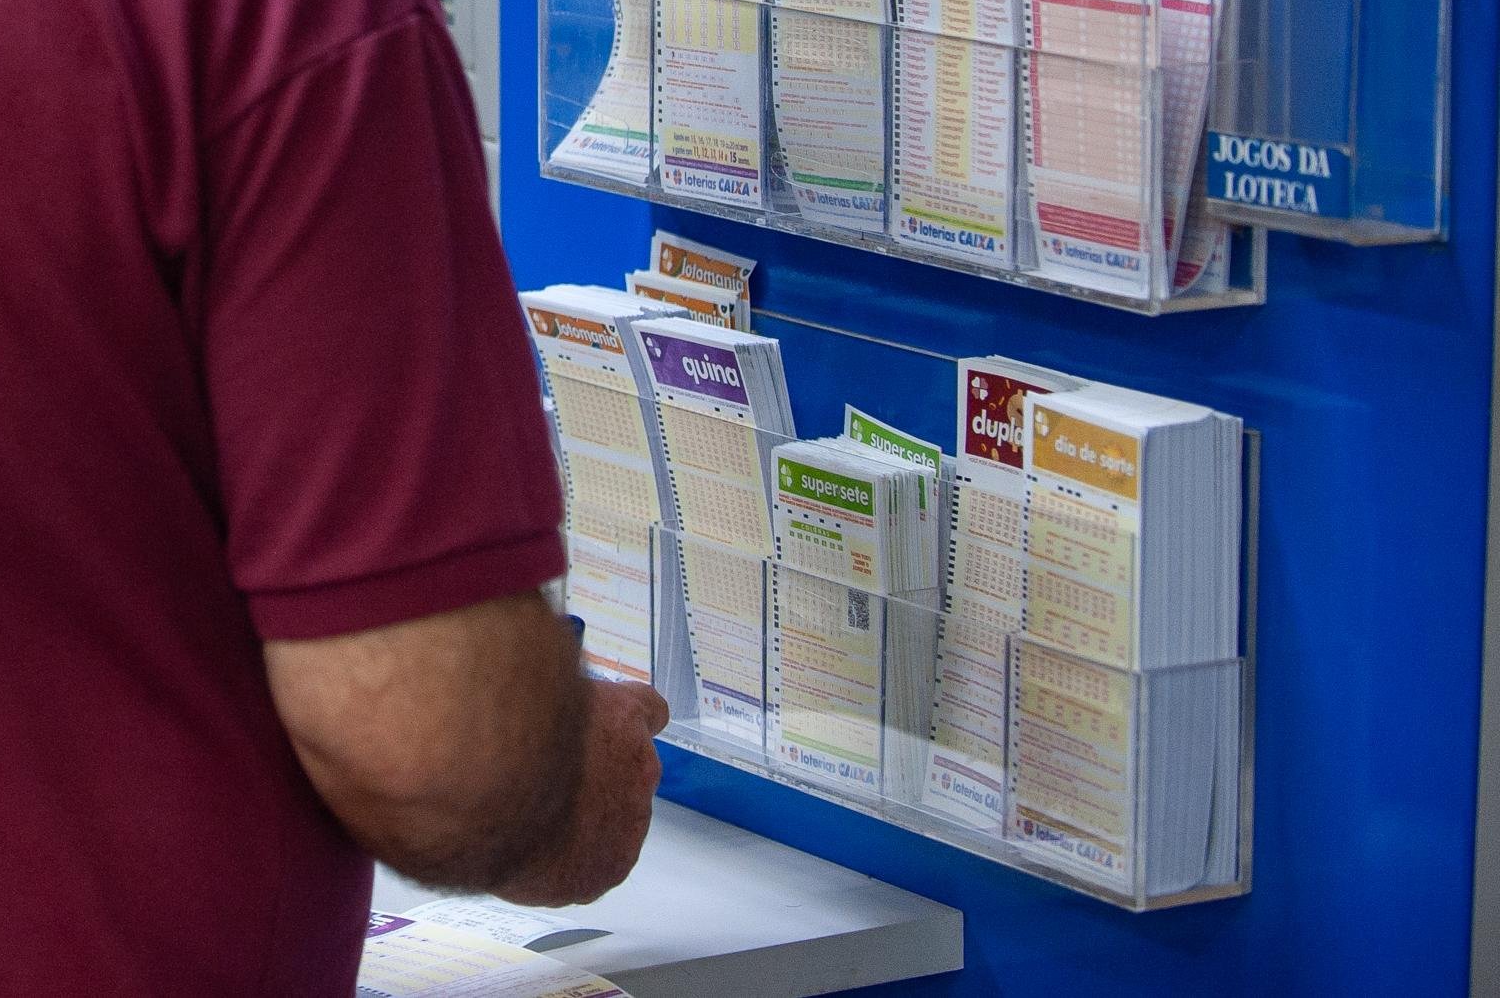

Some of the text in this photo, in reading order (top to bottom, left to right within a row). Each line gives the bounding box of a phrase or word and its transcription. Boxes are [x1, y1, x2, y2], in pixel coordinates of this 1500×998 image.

[1213, 134, 1331, 179] JOGOS DA
[684, 171, 750, 197] loterias CAIXA
[1224, 171, 1320, 214] LOTECA
[919, 220, 995, 252] loterias CAIXA
[680, 257, 744, 292] lotomania
[556, 318, 618, 349] lotomania
[682, 353, 740, 387] quina
[1055, 434, 1135, 477] dia de sorte
[800, 750, 836, 774] loterias
[952, 778, 983, 804] loterias
